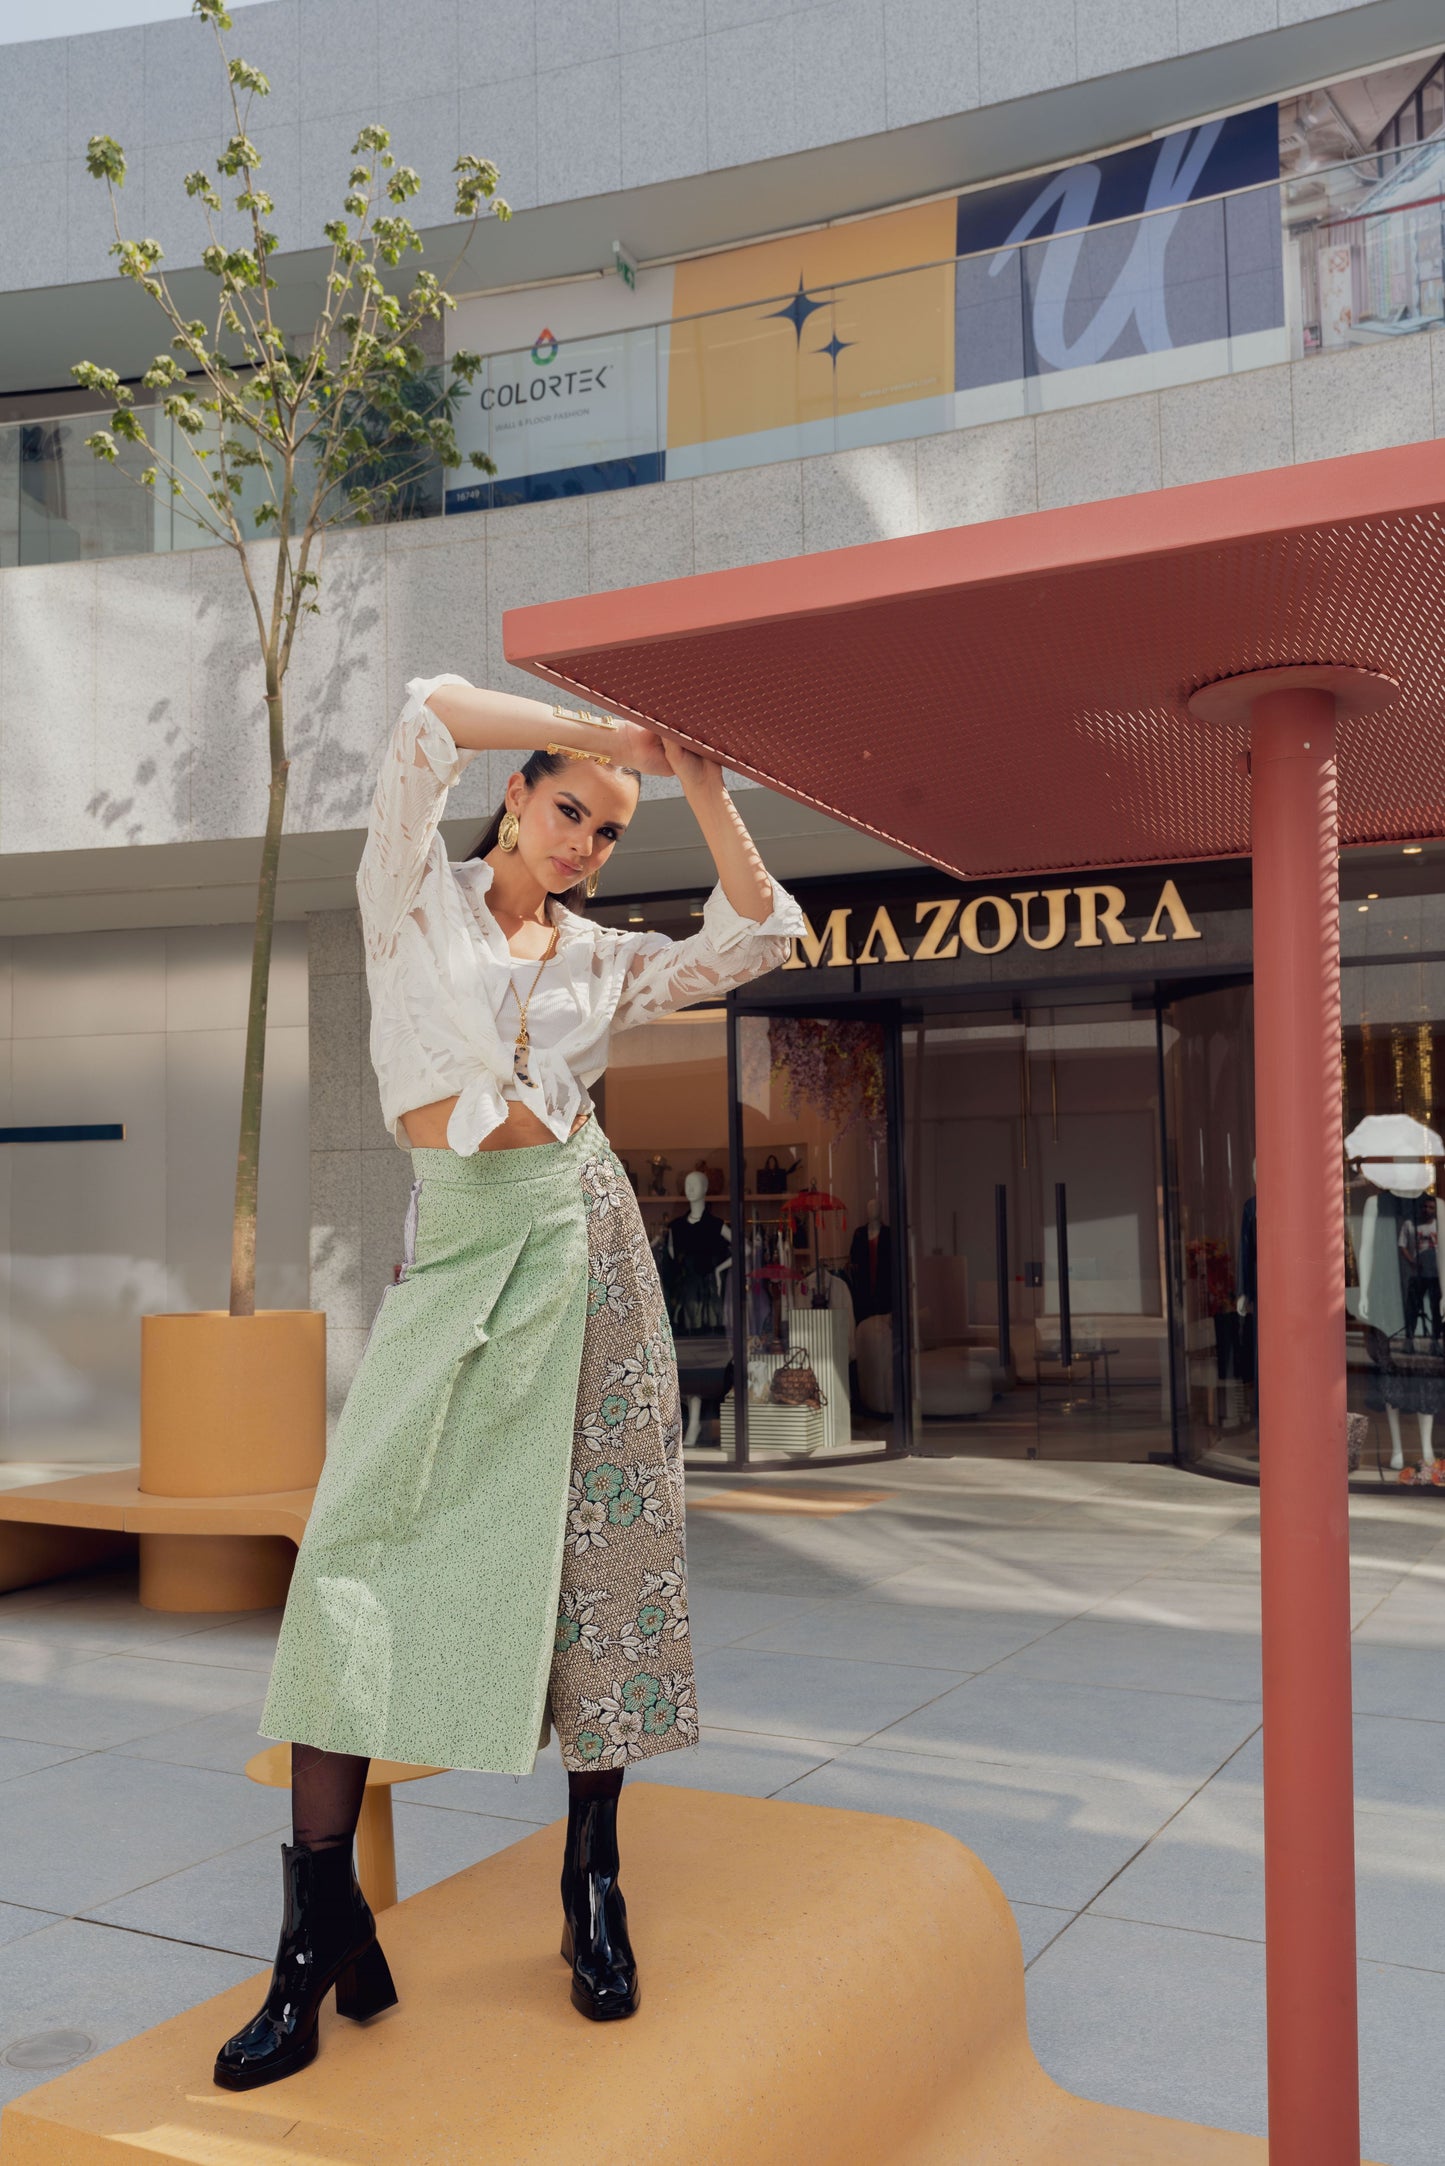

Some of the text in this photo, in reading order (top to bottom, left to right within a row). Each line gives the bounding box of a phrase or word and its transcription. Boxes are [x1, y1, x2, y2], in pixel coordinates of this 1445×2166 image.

[480, 365, 608, 411] COLORTEK
[495, 420, 516, 432] WALL
[524, 414, 552, 427] FLOOR
[553, 407, 590, 421] FASHION
[781, 879, 1202, 970] MAZOURA
